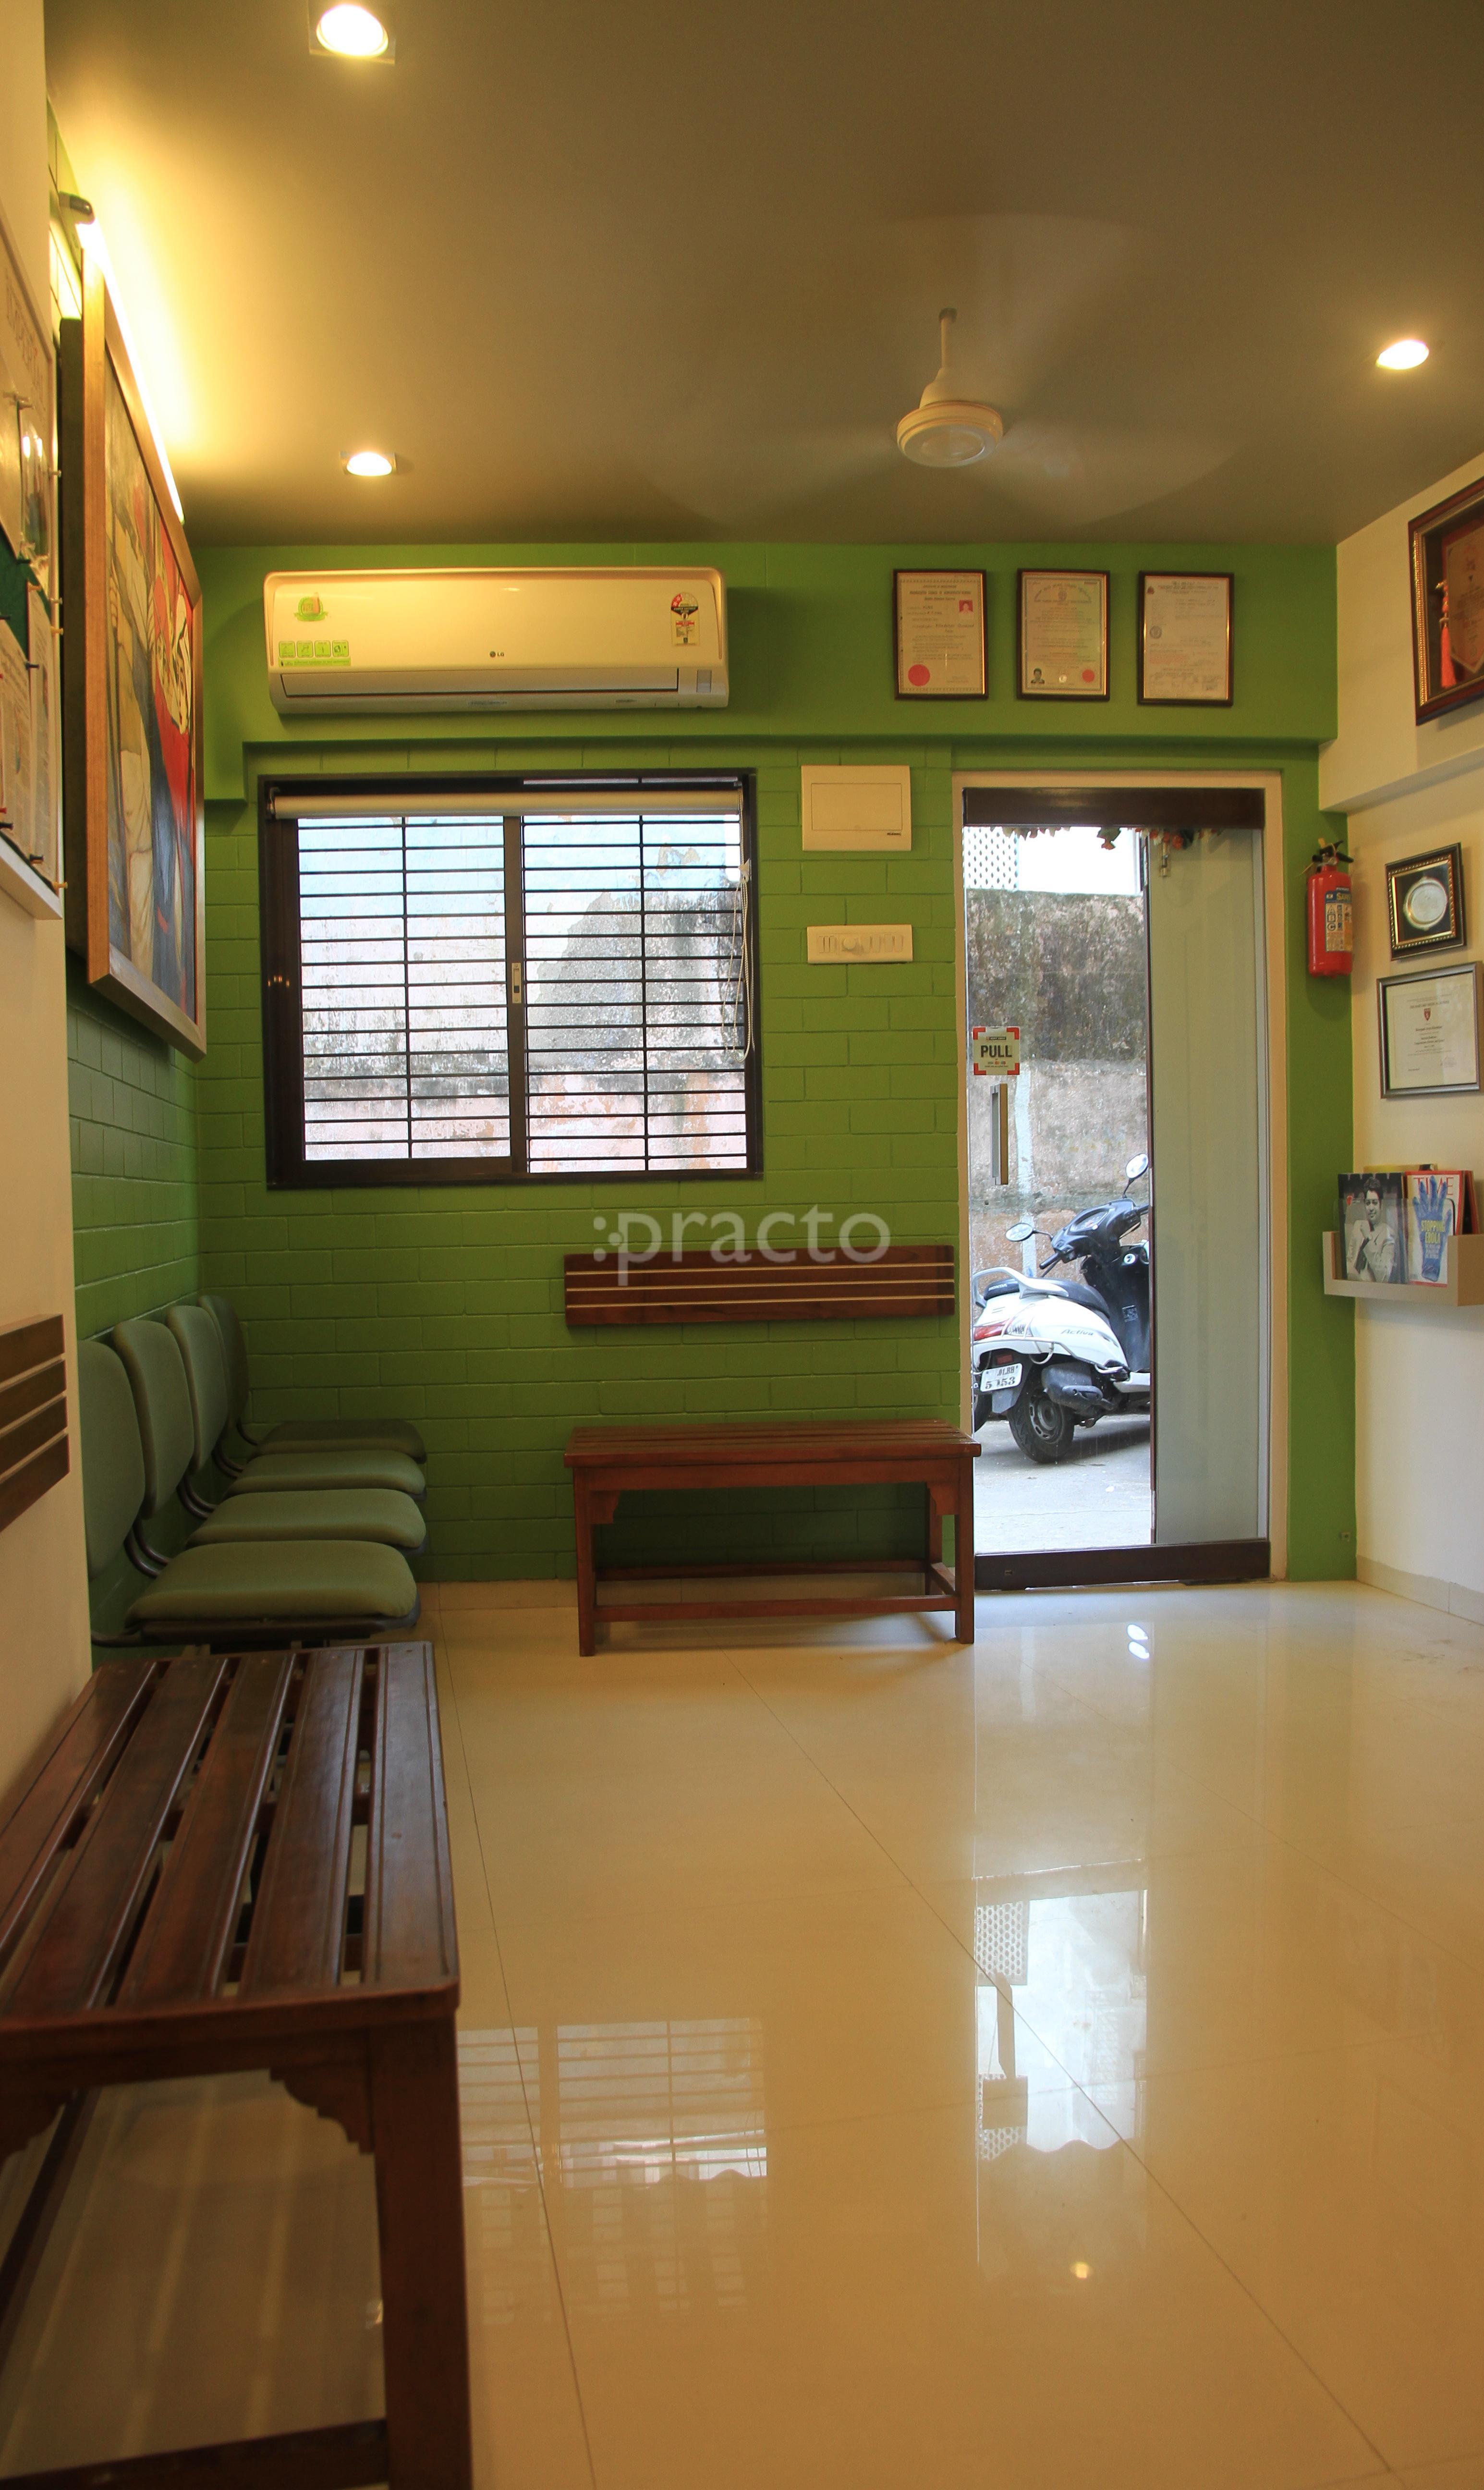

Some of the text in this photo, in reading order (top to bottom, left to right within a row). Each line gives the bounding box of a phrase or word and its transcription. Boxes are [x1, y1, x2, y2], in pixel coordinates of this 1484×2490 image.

[981, 1045, 1012, 1057] PULL
[1421, 1220, 1445, 1232] STOPPING
[1425, 1232, 1441, 1244] EBOLA
